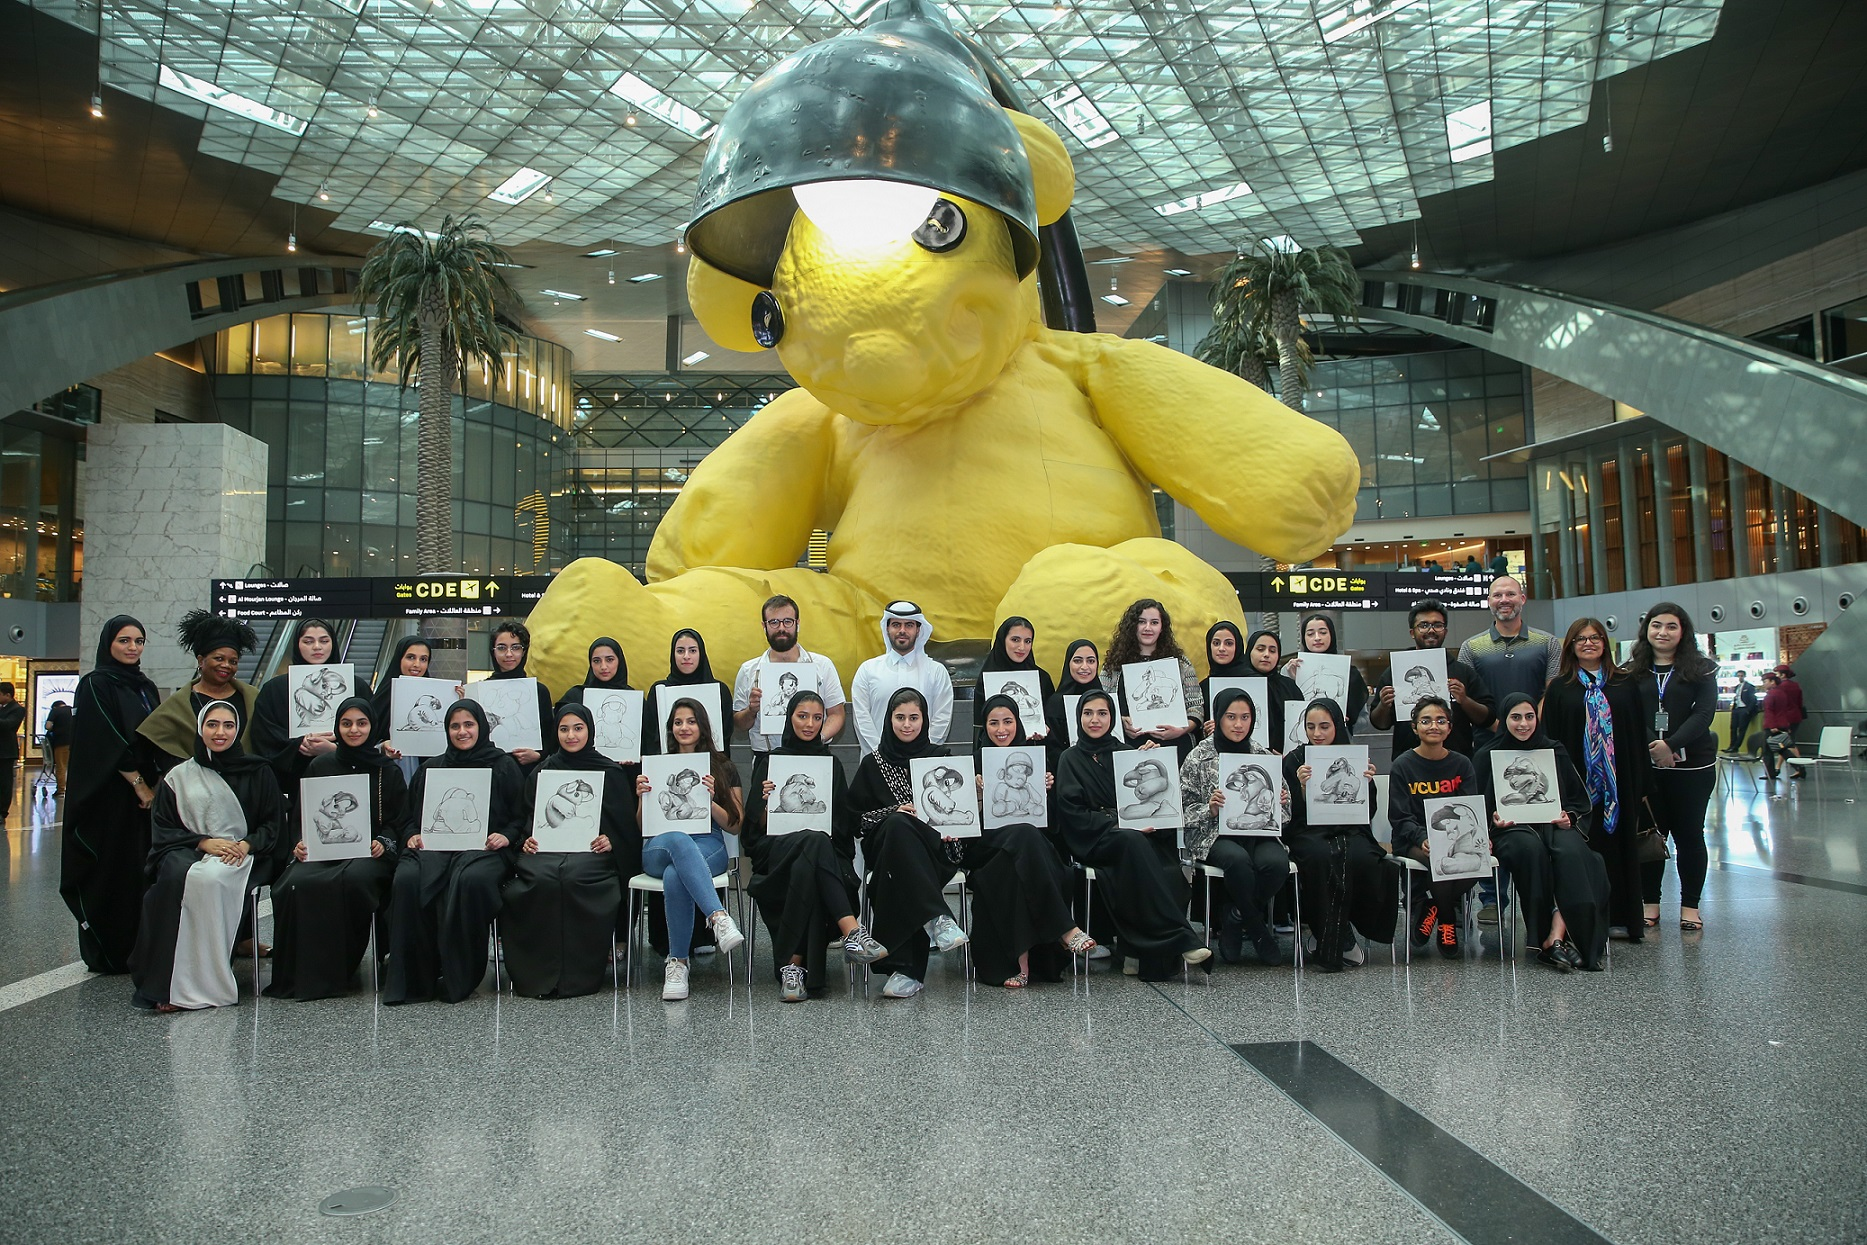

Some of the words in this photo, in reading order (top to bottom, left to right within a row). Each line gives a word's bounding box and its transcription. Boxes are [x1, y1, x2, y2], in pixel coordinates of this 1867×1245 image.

[244, 582, 267, 590] Lounges
[415, 582, 458, 598] CDE
[1309, 577, 1348, 592] CDE
[405, 608, 423, 616] Family
